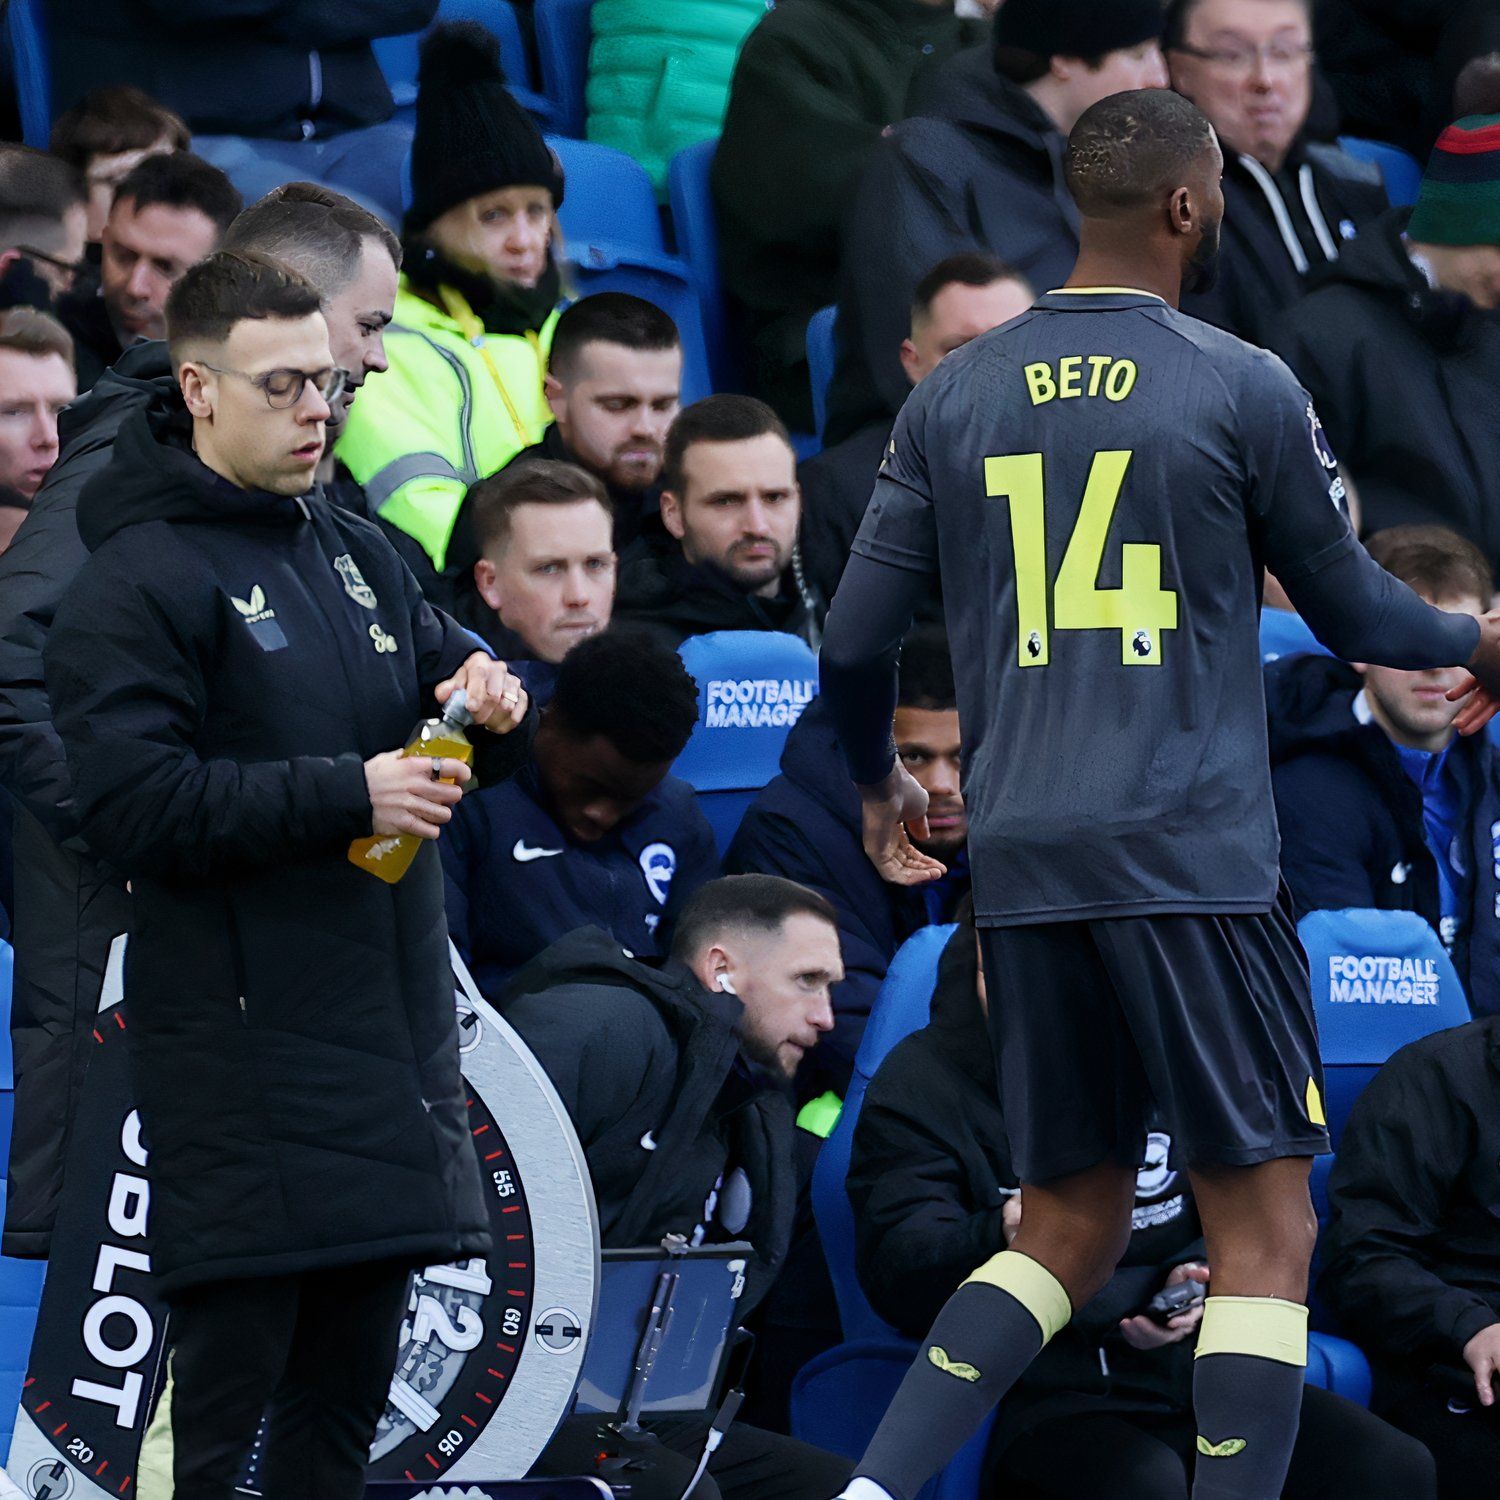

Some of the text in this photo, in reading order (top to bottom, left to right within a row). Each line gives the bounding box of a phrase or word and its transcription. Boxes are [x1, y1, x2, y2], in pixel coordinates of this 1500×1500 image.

[1024, 355, 1138, 405] BETO
[984, 449, 1177, 667] 14
[706, 703, 807, 728] MANAGE
[1329, 954, 1440, 982] FOOTBALL
[1329, 979, 1440, 1006] MANAGER
[493, 1170, 515, 1197] 55
[411, 1258, 492, 1351] 12
[502, 1308, 521, 1336] 60
[66, 1438, 94, 1463] 20
